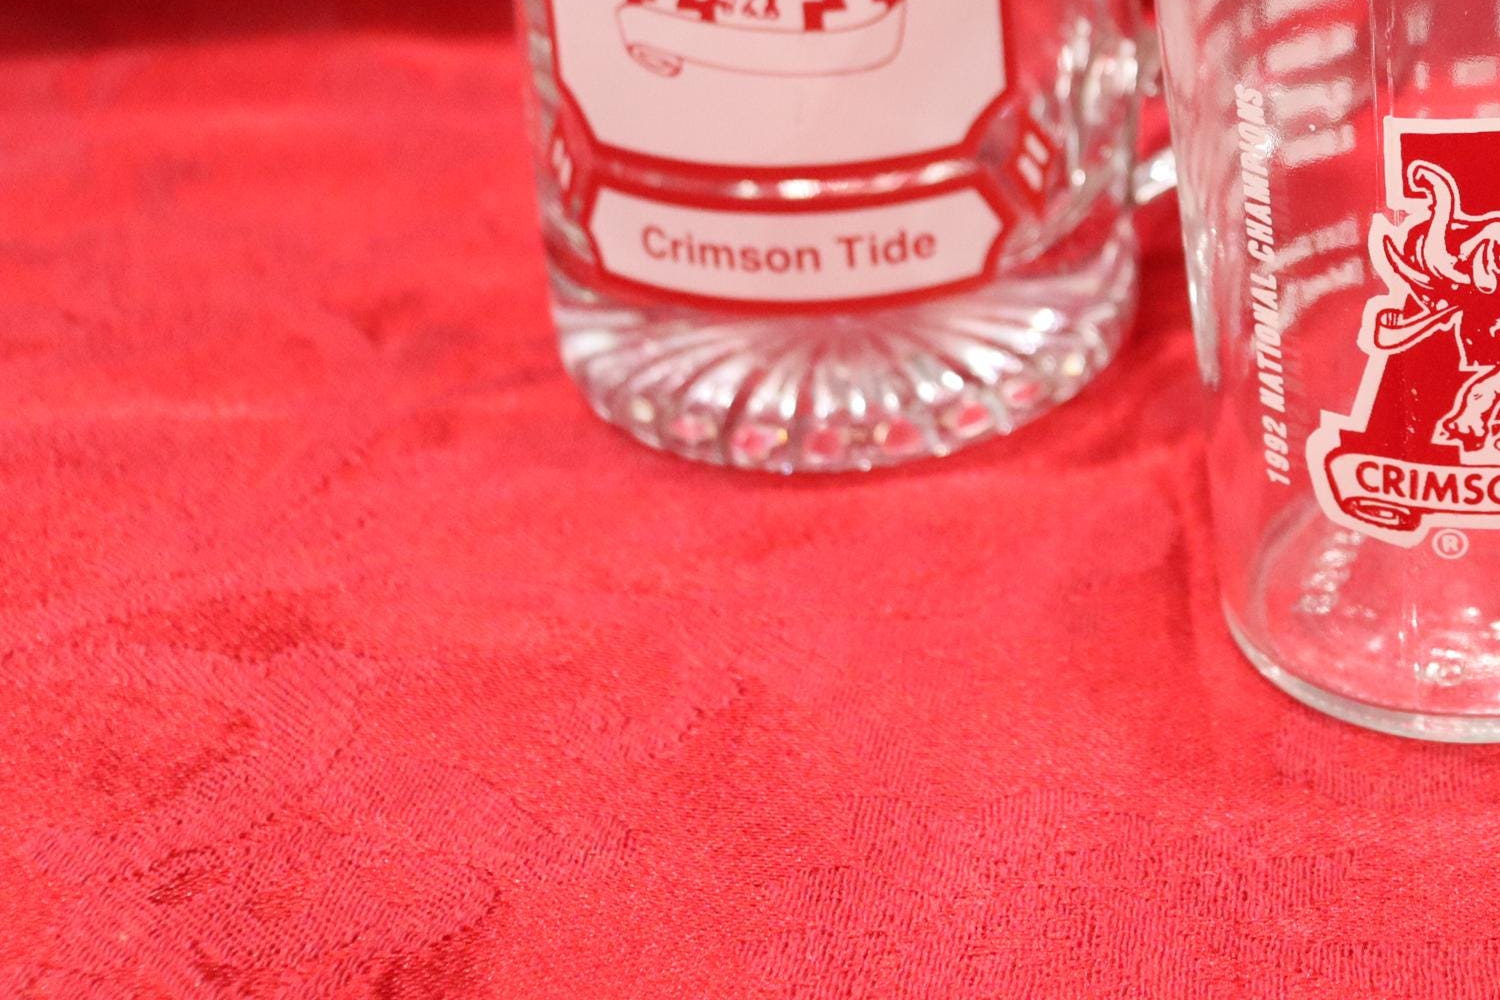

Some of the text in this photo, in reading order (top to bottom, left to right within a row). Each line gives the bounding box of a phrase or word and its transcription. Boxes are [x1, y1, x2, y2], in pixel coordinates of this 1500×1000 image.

[641, 226, 937, 272] Crimson Tide
[1234, 83, 1291, 485] 1992 NATIONAL CHAMPIONS
